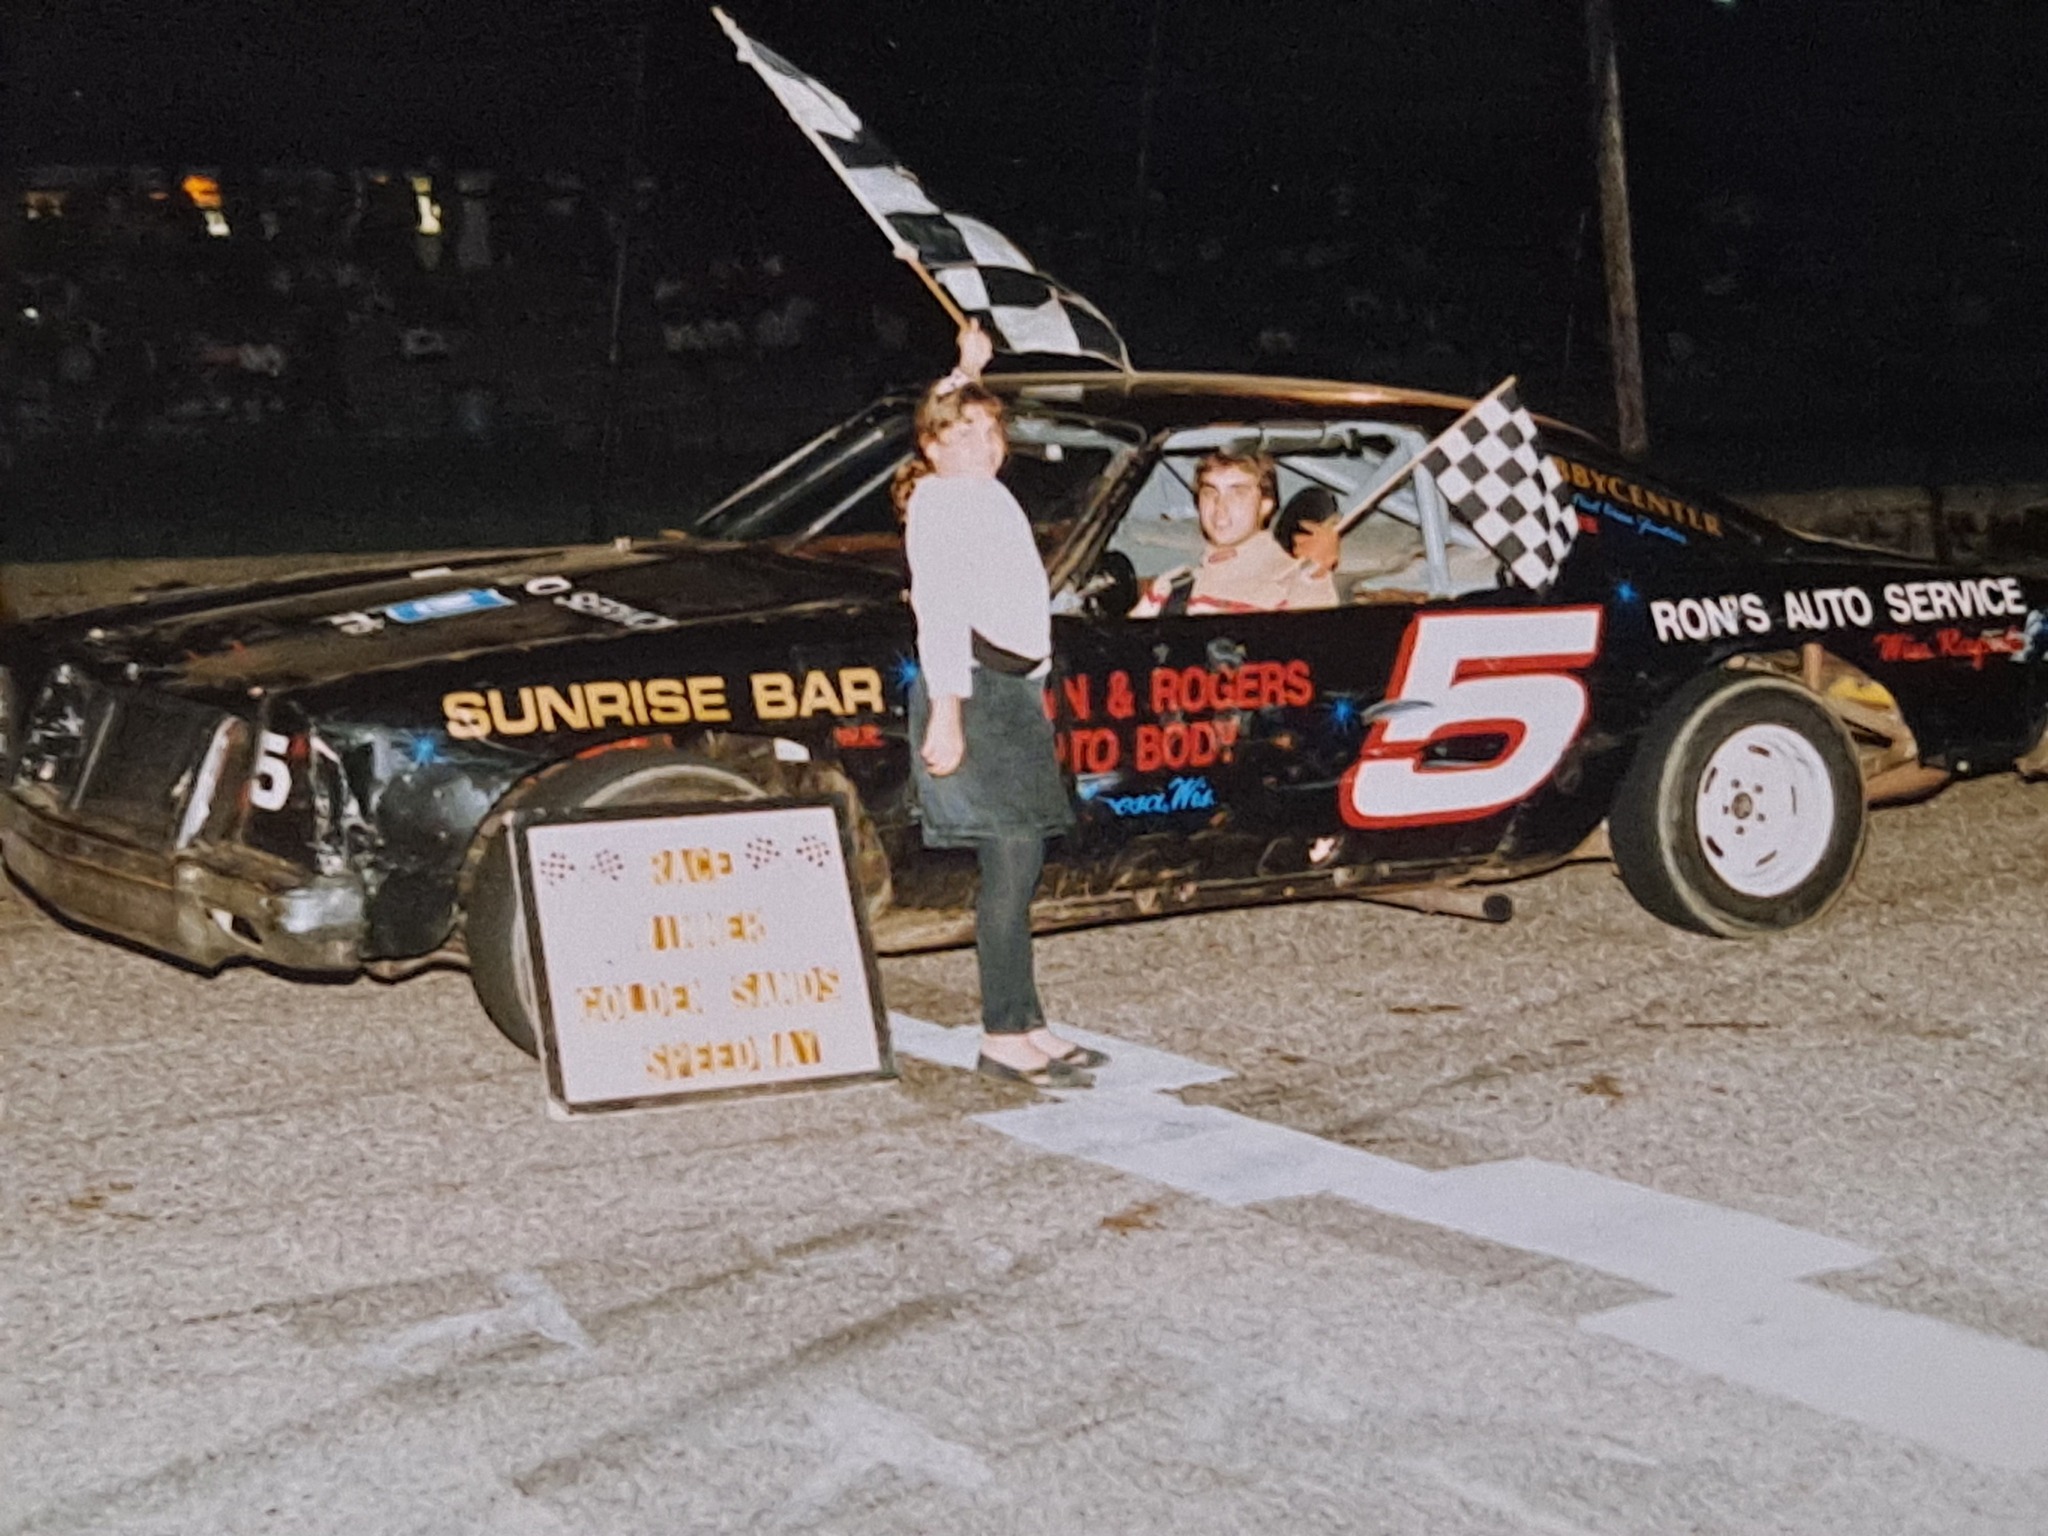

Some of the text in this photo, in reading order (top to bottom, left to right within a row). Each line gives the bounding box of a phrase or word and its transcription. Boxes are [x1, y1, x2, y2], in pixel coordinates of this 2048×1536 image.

[1650, 577, 2028, 643] RON'S AUTO SERVICE
[441, 667, 887, 740] SUNRISE BAR
[1106, 669, 1136, 719] &
[1150, 659, 1314, 714] ROGERS
[1339, 603, 1602, 830] 5
[249, 728, 293, 812] 5
[1134, 715, 1240, 773] BODY
